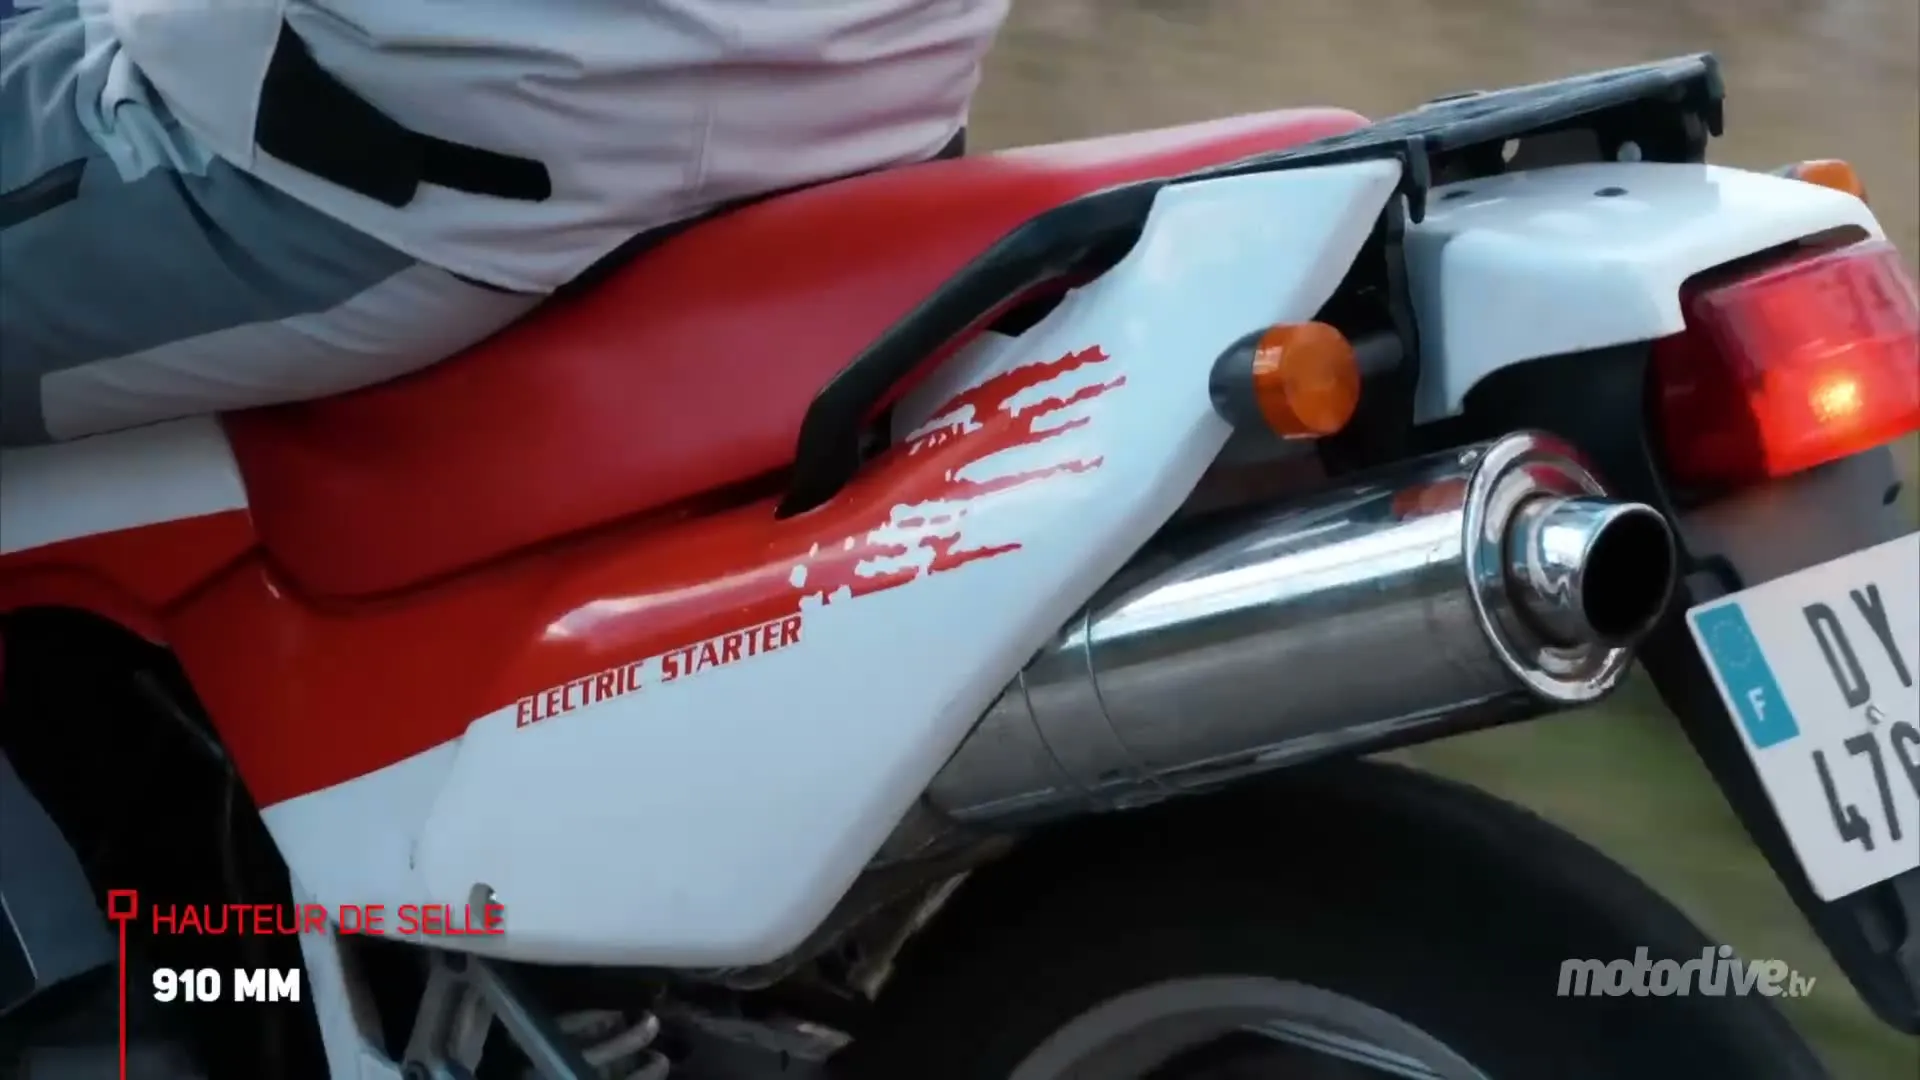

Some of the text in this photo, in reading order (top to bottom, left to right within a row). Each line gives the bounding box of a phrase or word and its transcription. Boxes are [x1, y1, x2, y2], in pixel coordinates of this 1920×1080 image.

[516, 613, 802, 729] ELECTRIC STARTER
[1802, 582, 1912, 708] DY
[1746, 686, 1766, 722] F
